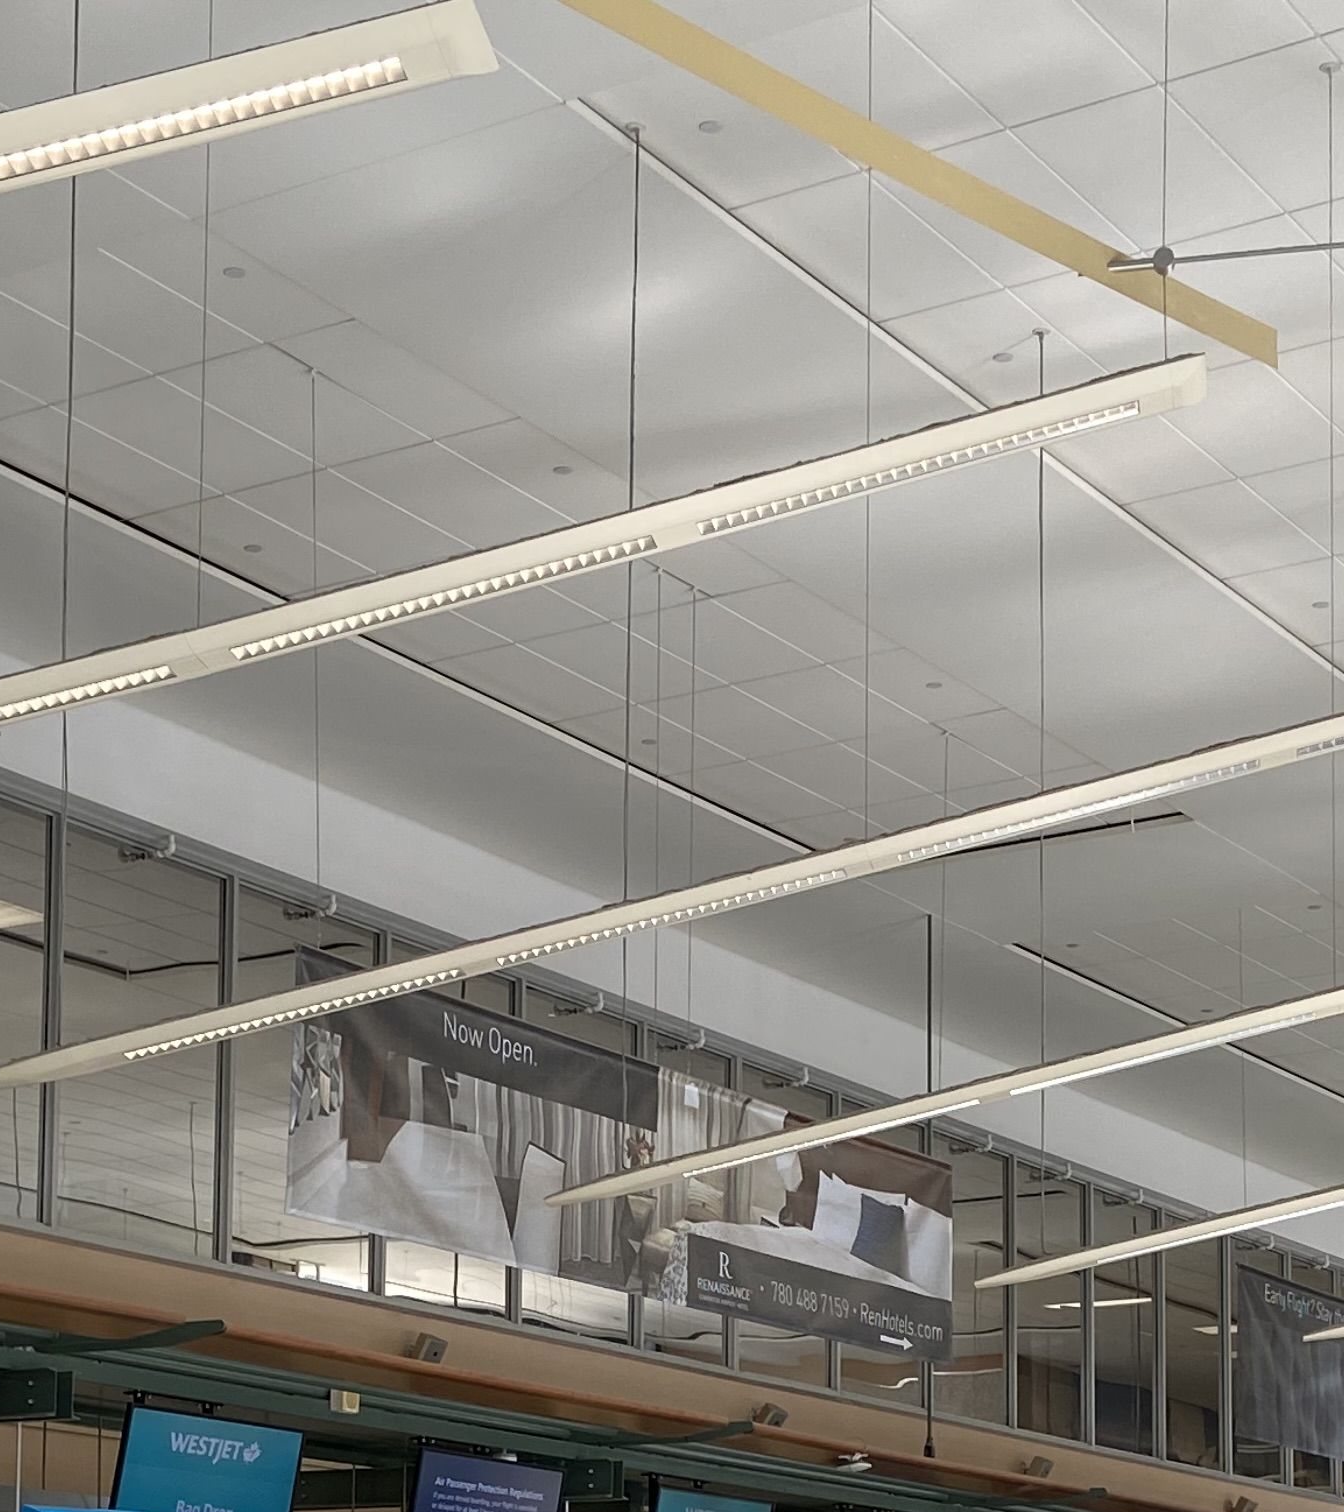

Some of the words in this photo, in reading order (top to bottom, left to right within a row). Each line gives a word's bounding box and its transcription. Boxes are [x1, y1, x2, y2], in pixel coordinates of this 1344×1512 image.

[443, 1011, 484, 1048] Now
[488, 1027, 538, 1067] Open.
[719, 1251, 734, 1280] R
[696, 1277, 751, 1302] RENAISSANCE
[770, 1281, 793, 1307] 780
[796, 1287, 818, 1313] 488
[820, 1293, 850, 1319] 7159
[860, 1302, 944, 1342] RenHotels.com
[170, 1431, 244, 1464] WESTJET
